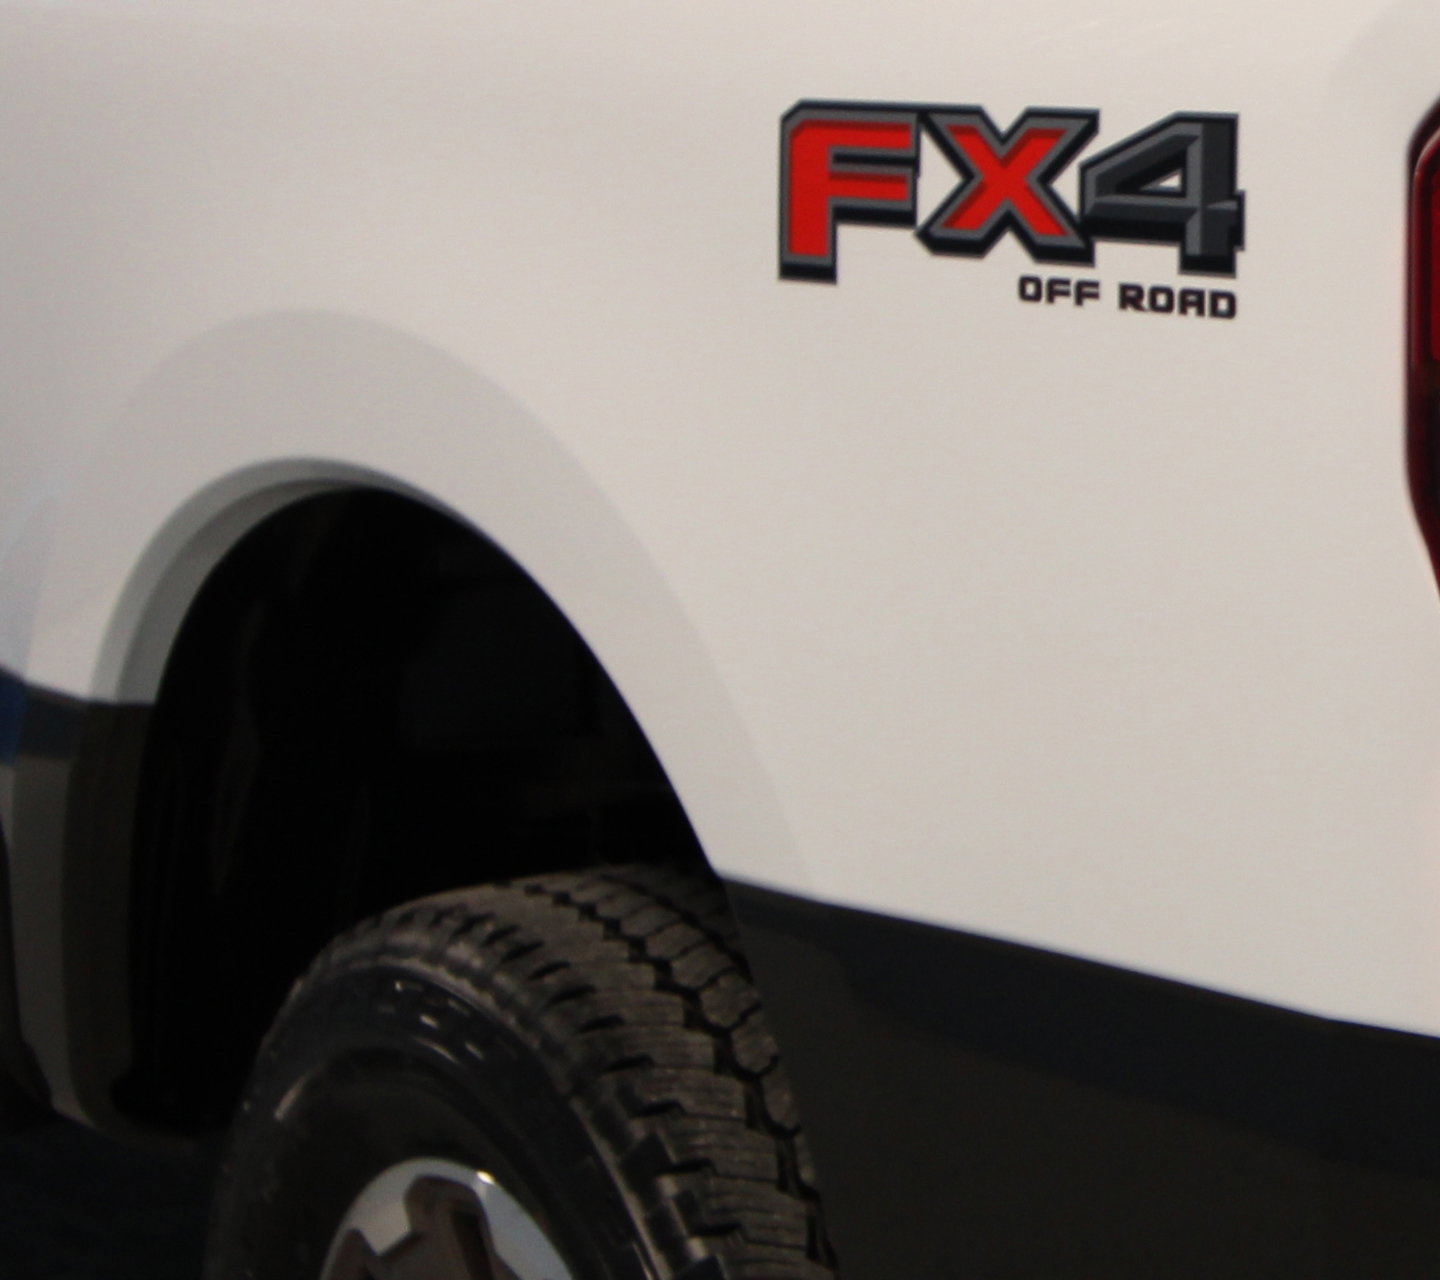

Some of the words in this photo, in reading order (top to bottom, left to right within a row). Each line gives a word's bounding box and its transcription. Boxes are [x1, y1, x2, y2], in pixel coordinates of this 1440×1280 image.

[779, 98, 1245, 285] FX4
[1018, 275, 1100, 307] OFF
[1118, 283, 1238, 320] ROAD
